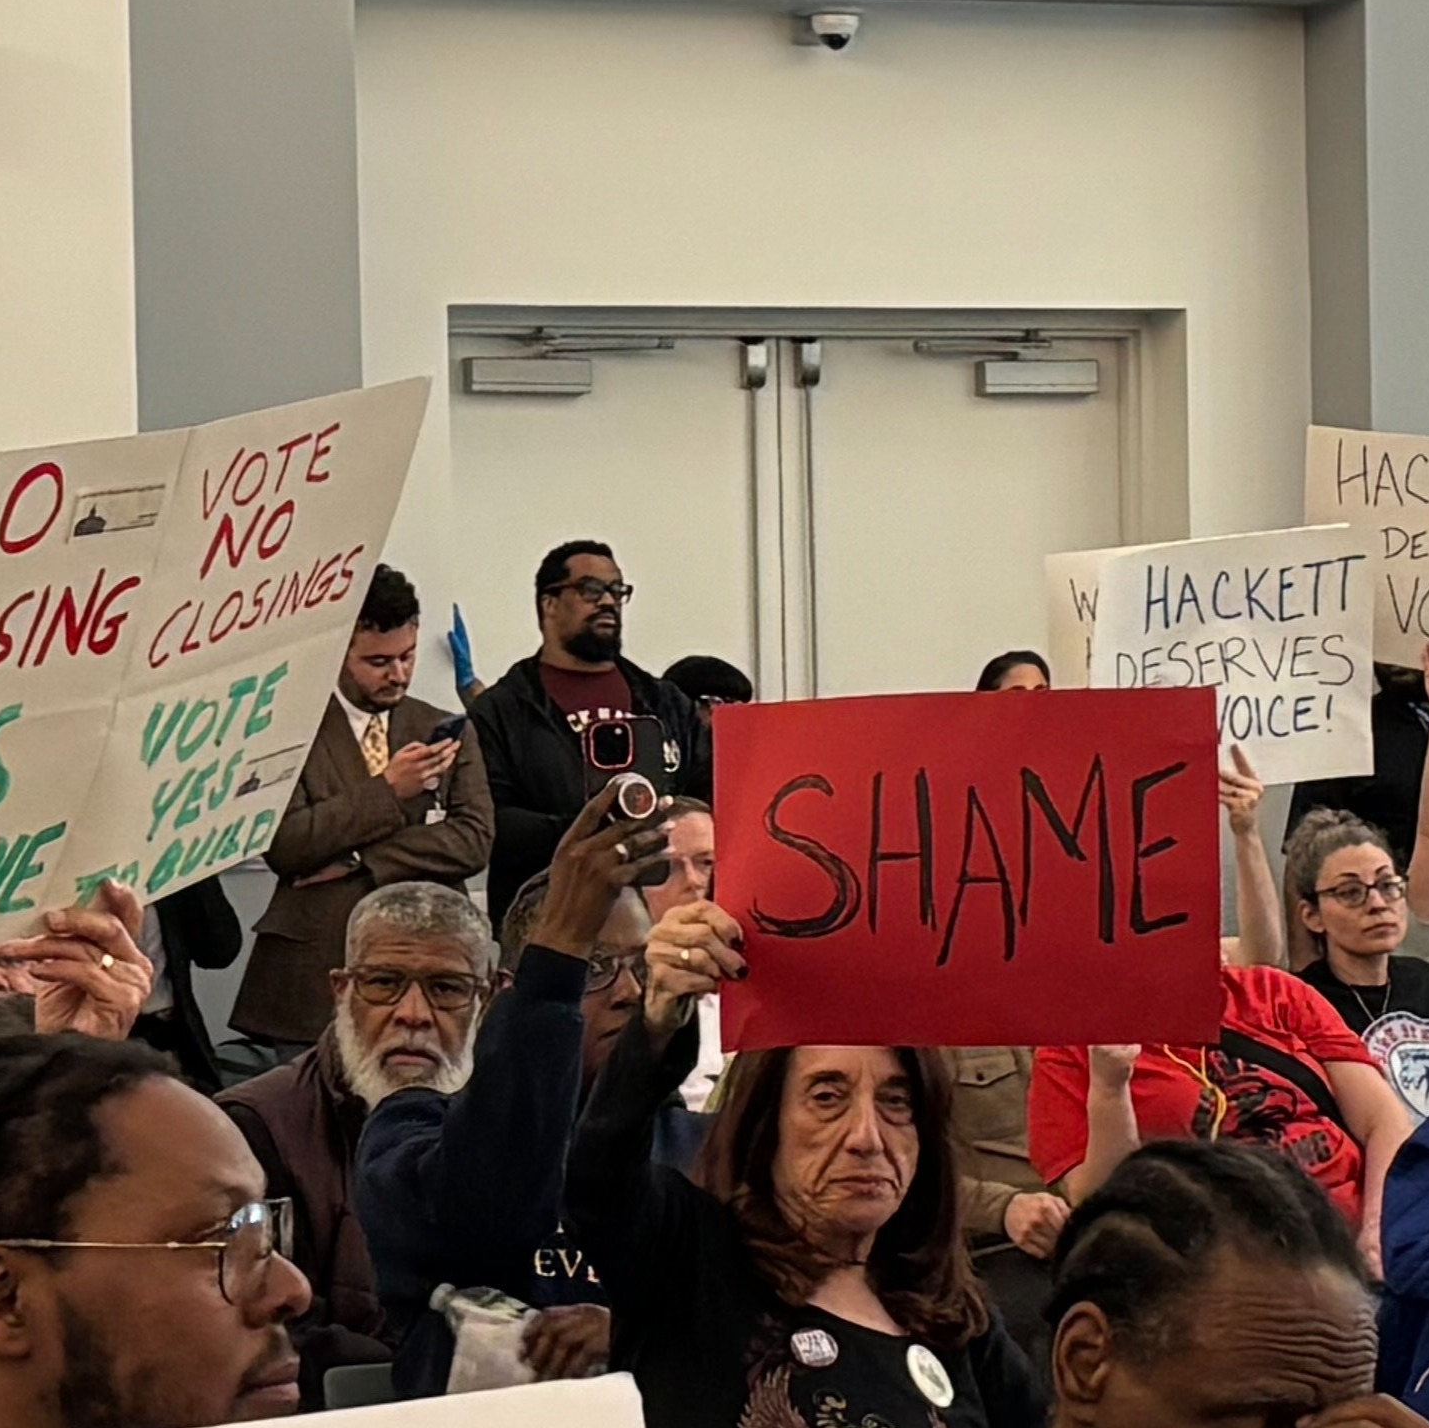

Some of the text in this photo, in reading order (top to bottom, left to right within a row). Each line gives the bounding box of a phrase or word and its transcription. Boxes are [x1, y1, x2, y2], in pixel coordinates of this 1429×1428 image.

[202, 422, 340, 521] VOTE
[200, 499, 295, 579] NO
[148, 543, 365, 669] CLOSINGS
[1144, 554, 1368, 635] HACKETT
[1116, 633, 1354, 688] DESERVES
[140, 661, 289, 769] VOTE
[146, 748, 245, 842] YES
[146, 809, 276, 895] BUILD
[748, 753, 1190, 966] SHAME
